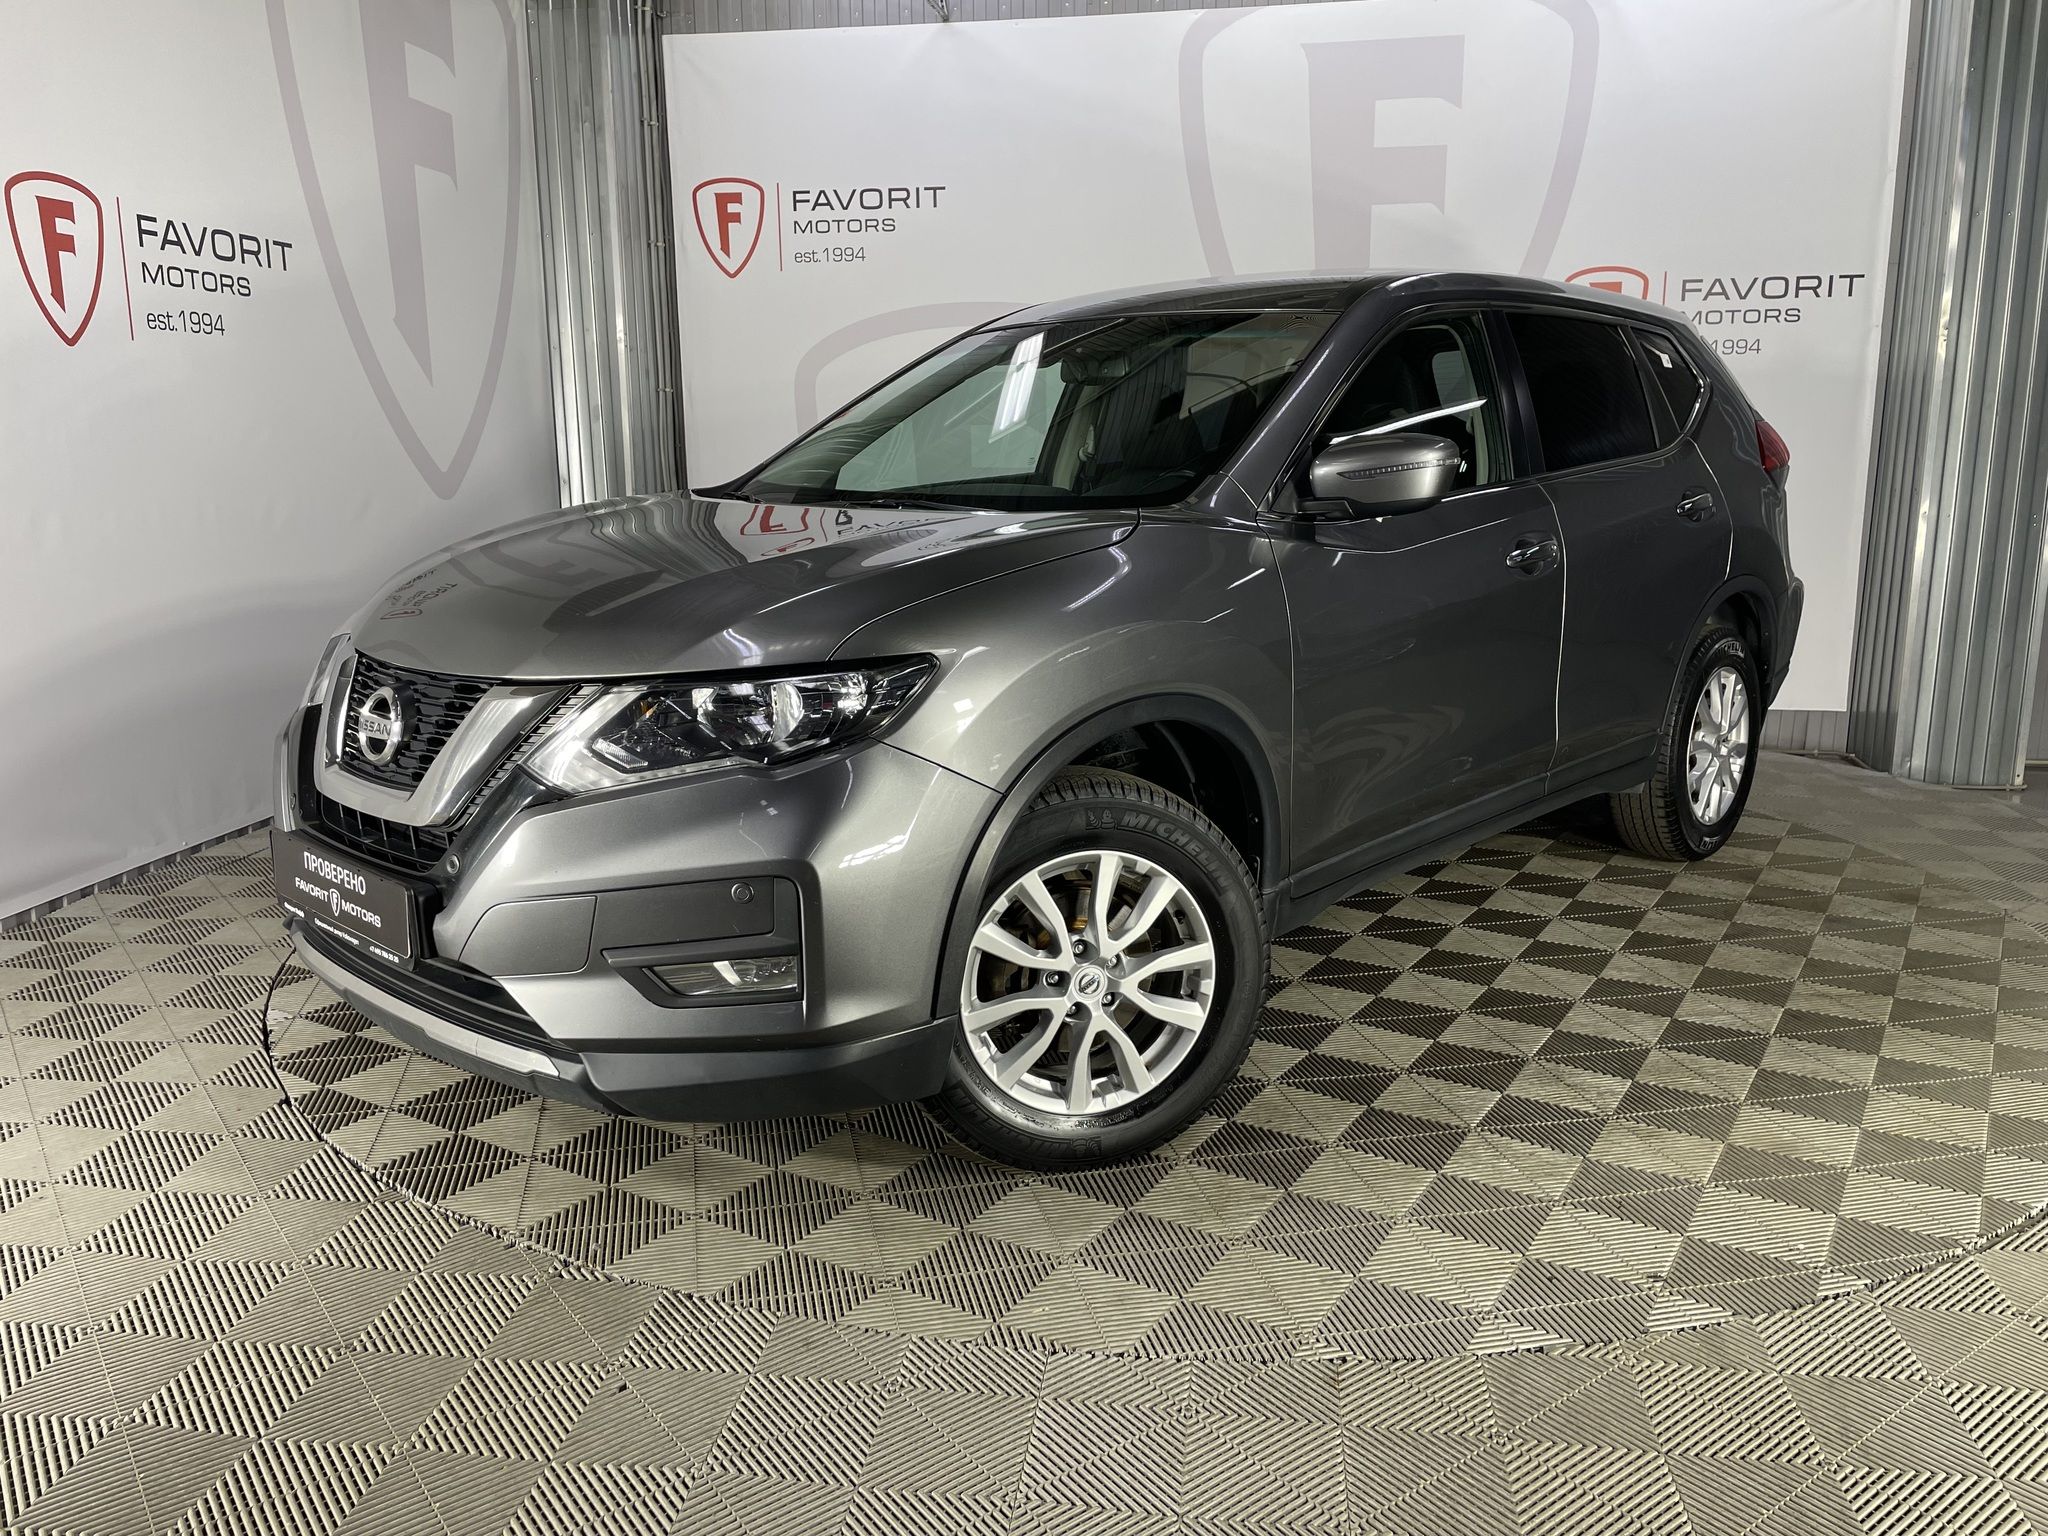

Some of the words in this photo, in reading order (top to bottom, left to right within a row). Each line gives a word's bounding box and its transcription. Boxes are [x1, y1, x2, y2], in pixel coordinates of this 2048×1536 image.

[792, 185, 946, 213] FAVORIT
[793, 217, 896, 235] MOTORS
[136, 213, 293, 272] FAVORIT
[794, 246, 867, 263] est.1994
[141, 261, 252, 298] MOTORS
[1680, 273, 1866, 302] FAVORIT
[146, 310, 226, 336] est.1994
[1711, 338, 1762, 356] 1994
[360, 717, 391, 736] NISSAN
[1119, 810, 1235, 890] MICHELIN
[303, 851, 366, 895] ПРОВЕРЕНО
[294, 876, 329, 903] FAVORIT
[341, 899, 382, 928] MOTORS
